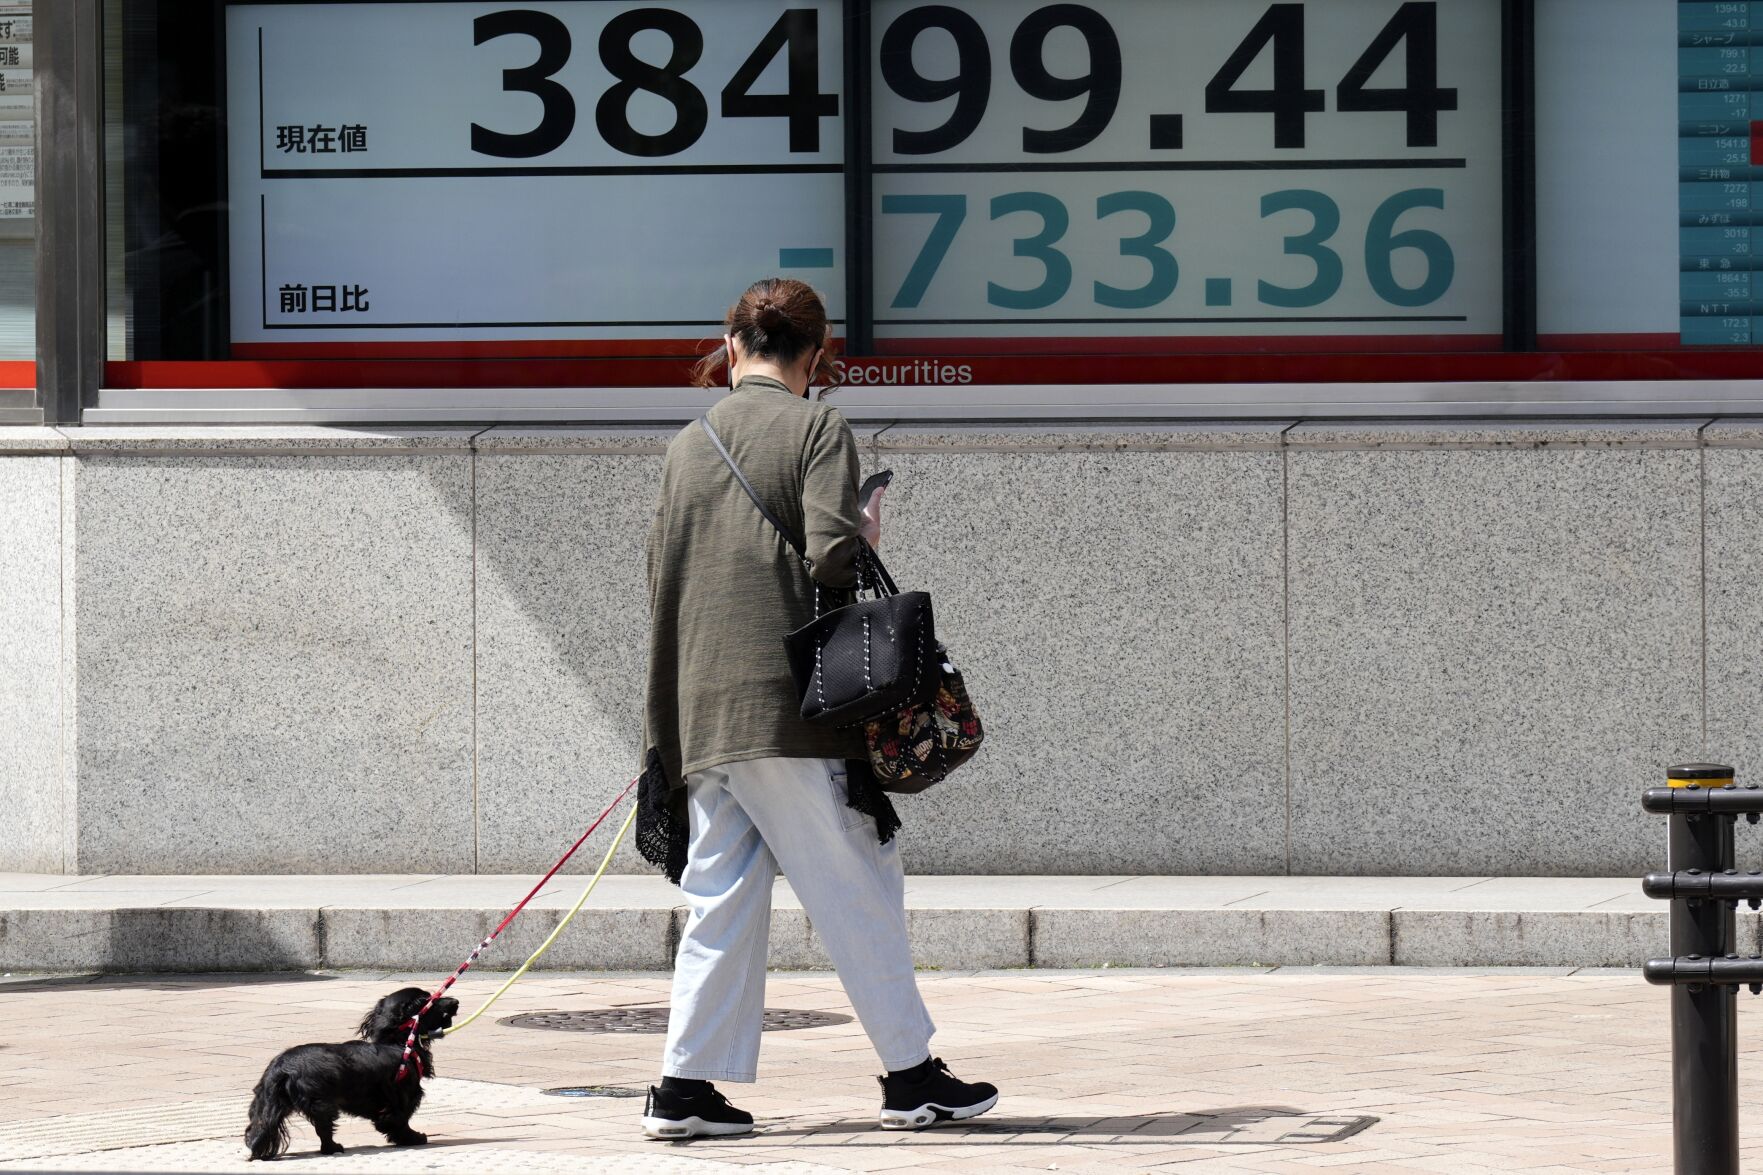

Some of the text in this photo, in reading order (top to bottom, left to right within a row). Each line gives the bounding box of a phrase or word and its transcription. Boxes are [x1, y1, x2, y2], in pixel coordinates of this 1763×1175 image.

[471, 2, 1457, 158] 38499.44
[1724, 94, 1746, 103] 1271
[1730, 108, 1746, 118] -17
[1698, 124, 1730, 134] ニコン
[276, 124, 368, 153] 現在値
[1698, 168, 1730, 179] 三井物
[1724, 183, 1747, 193] 7272
[1698, 213, 1730, 224] みずほ
[1724, 228, 1748, 238] 3019
[1732, 243, 1748, 253] -20
[279, 284, 370, 312] 前日比
[1722, 318, 1749, 328] 172.3
[832, 360, 973, 384] Securities
